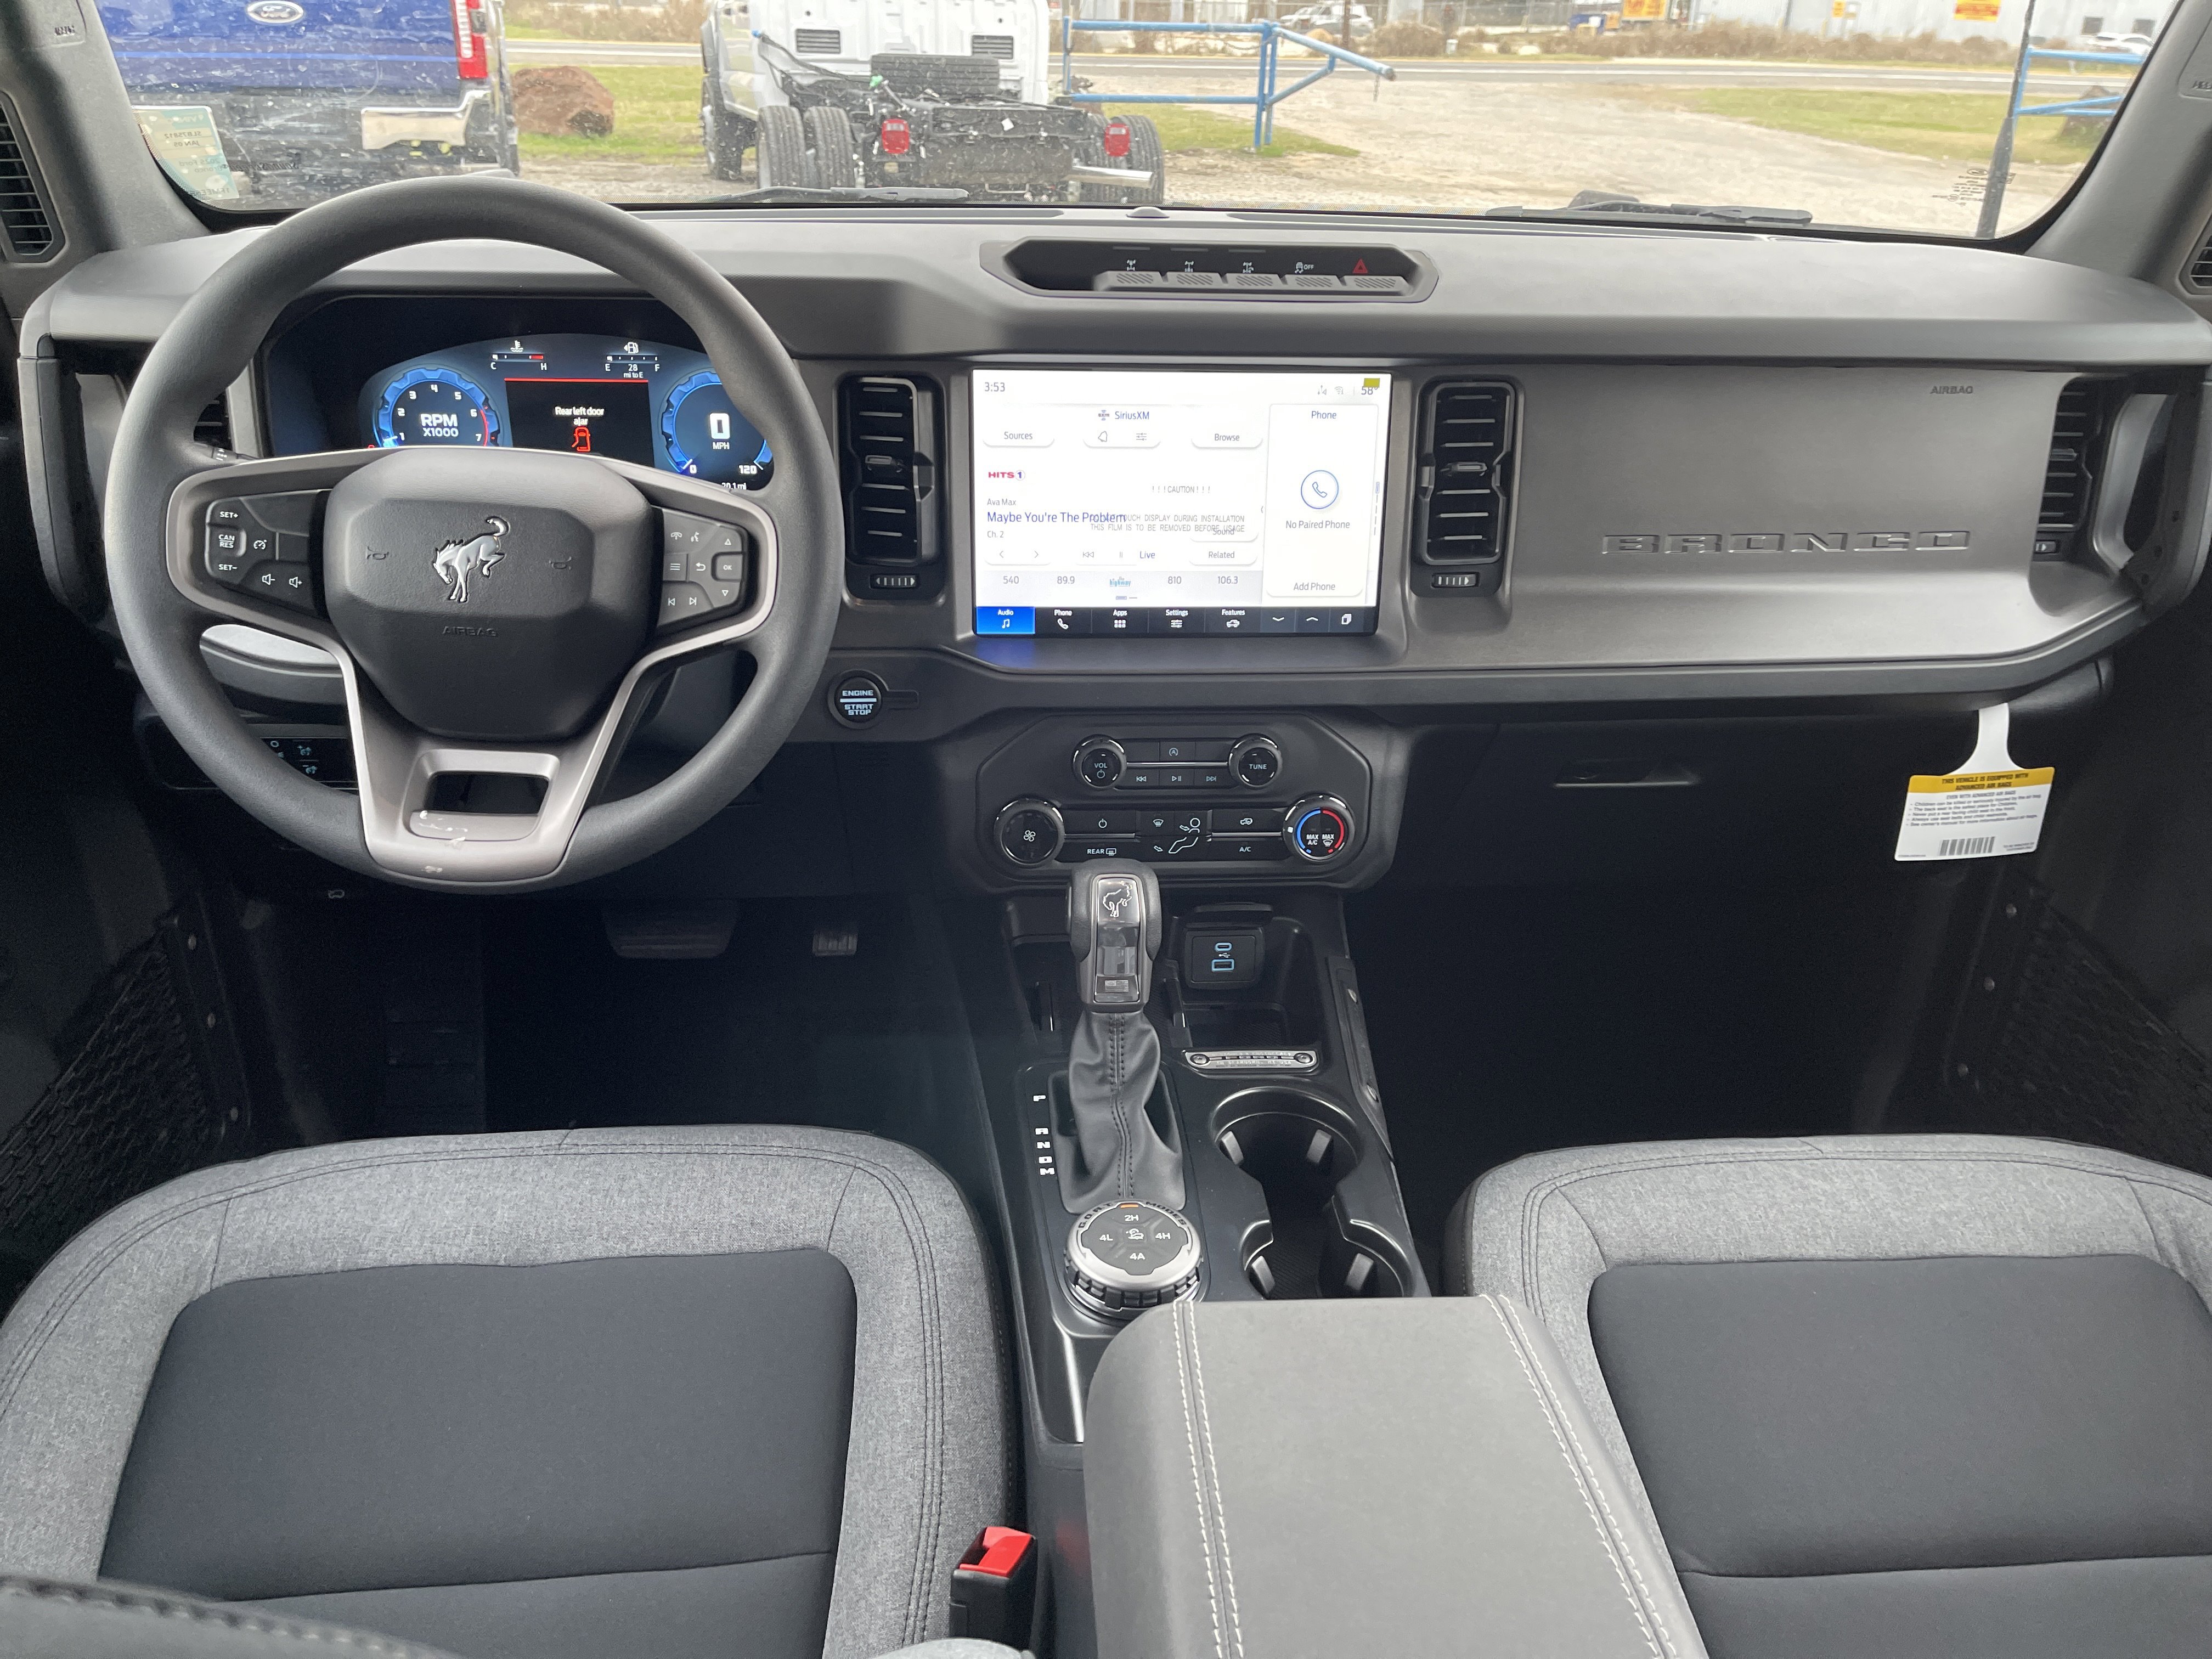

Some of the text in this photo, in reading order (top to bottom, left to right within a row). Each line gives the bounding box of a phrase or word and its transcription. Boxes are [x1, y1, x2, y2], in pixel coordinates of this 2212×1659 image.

[430, 384, 438, 393] 4
[984, 382, 1006, 392] 3:53
[409, 391, 417, 399] 3
[454, 392, 462, 400] 5
[397, 408, 405, 416] 2
[470, 409, 477, 417] 6
[555, 407, 604, 416] Rear left door
[1115, 411, 1149, 420] SiriusXM
[1311, 410, 1337, 419] Phone
[420, 414, 458, 427] RPM
[573, 417, 588, 426] ajar
[709, 413, 730, 439] 0
[399, 432, 405, 441] 1
[423, 427, 459, 437] X1000
[1004, 431, 1033, 439] Sources
[475, 433, 482, 442] 7
[1214, 433, 1240, 442] Browse
[689, 465, 697, 474] 0
[738, 465, 757, 474] 120
[987, 511, 1022, 524] Maybe
[1025, 511, 1057, 523] You're
[1060, 512, 1080, 523] The
[1082, 512, 1126, 523] Problem
[1201, 515, 1245, 523] INSTALLATION
[1285, 520, 1350, 529] No Paired Phone
[1601, 530, 1970, 554] BRONCO
[1003, 576, 1019, 584] 540
[1057, 576, 1075, 584] 89.9
[1167, 576, 1182, 584] 810
[1217, 576, 1238, 584] 106.3
[1293, 582, 1336, 591] Add Phone
[1146, 1201, 1187, 1226] MODES
